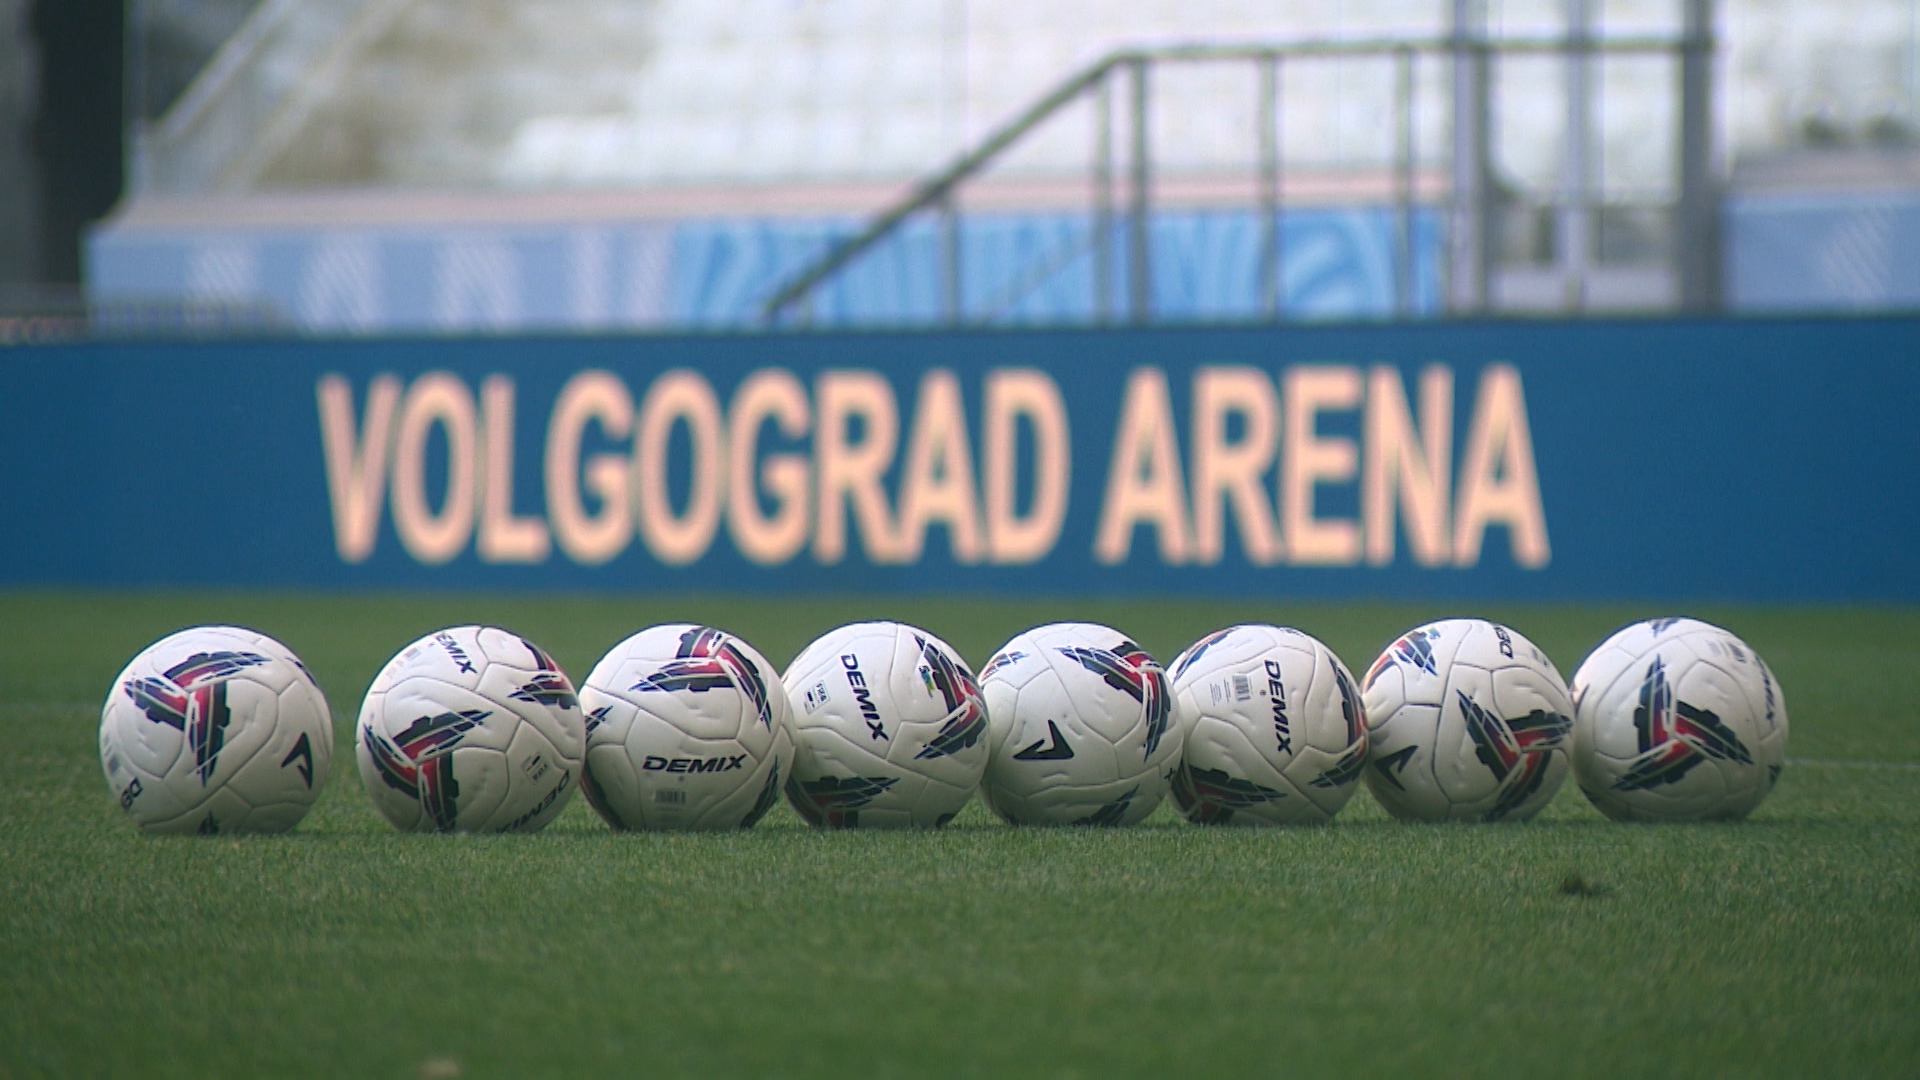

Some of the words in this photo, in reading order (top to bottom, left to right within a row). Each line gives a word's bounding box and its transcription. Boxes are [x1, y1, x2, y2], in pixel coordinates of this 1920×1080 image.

[317, 367, 1072, 566] VOLGOGRAD
[1094, 363, 1552, 571] ARENA
[436, 632, 478, 674] EMIX
[841, 653, 889, 741] DEMIX
[1264, 659, 1292, 756] DEMIX
[642, 753, 747, 774] DEMIX
